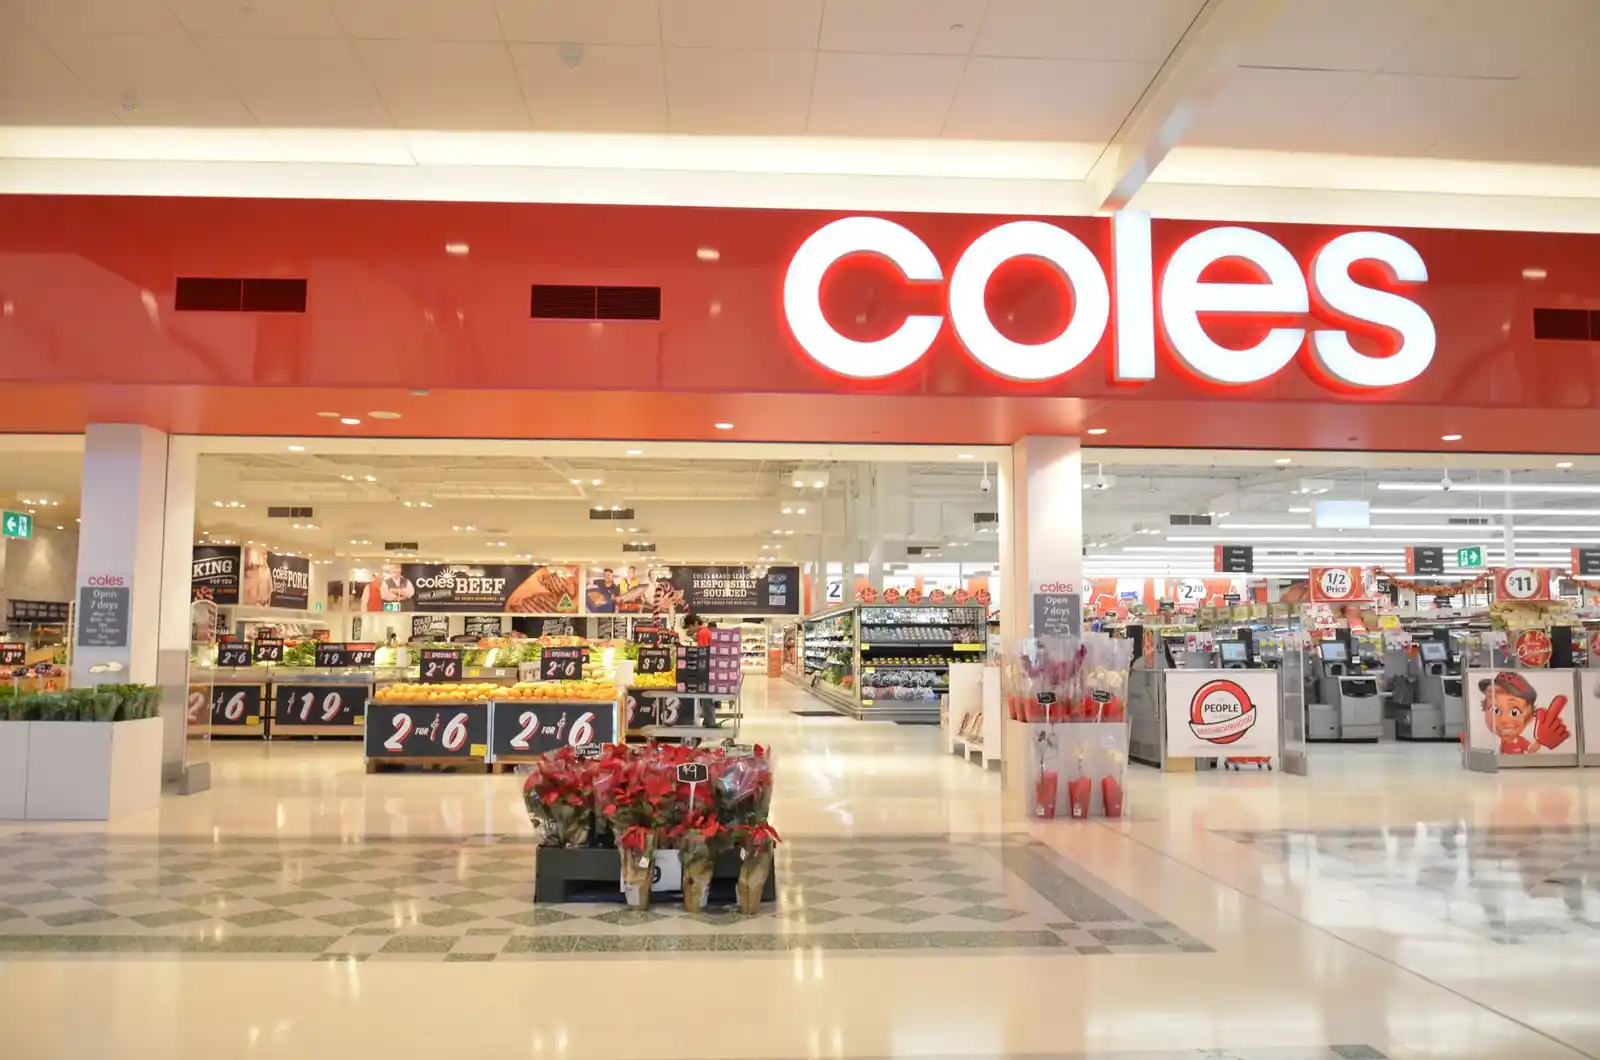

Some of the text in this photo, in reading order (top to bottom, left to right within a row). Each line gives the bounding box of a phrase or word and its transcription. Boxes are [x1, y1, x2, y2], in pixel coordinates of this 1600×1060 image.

[783, 211, 1436, 386] coles
[88, 575, 124, 586] coles
[288, 570, 308, 589] PORK
[1327, 573, 1346, 584] 1/2
[1508, 576, 1533, 592] $11
[416, 576, 454, 588] coles
[455, 578, 506, 594] BEEF
[1040, 580, 1073, 592] coles
[1326, 585, 1347, 593] Price
[93, 589, 117, 599] Open
[97, 600, 118, 611] days
[1045, 596, 1068, 605] Open
[1050, 606, 1070, 617] days
[1204, 703, 1239, 713] PEOPLE
[384, 712, 413, 751] 2
[414, 727, 429, 736] FOR
[510, 711, 540, 750] 2
[541, 726, 556, 735] FOR
